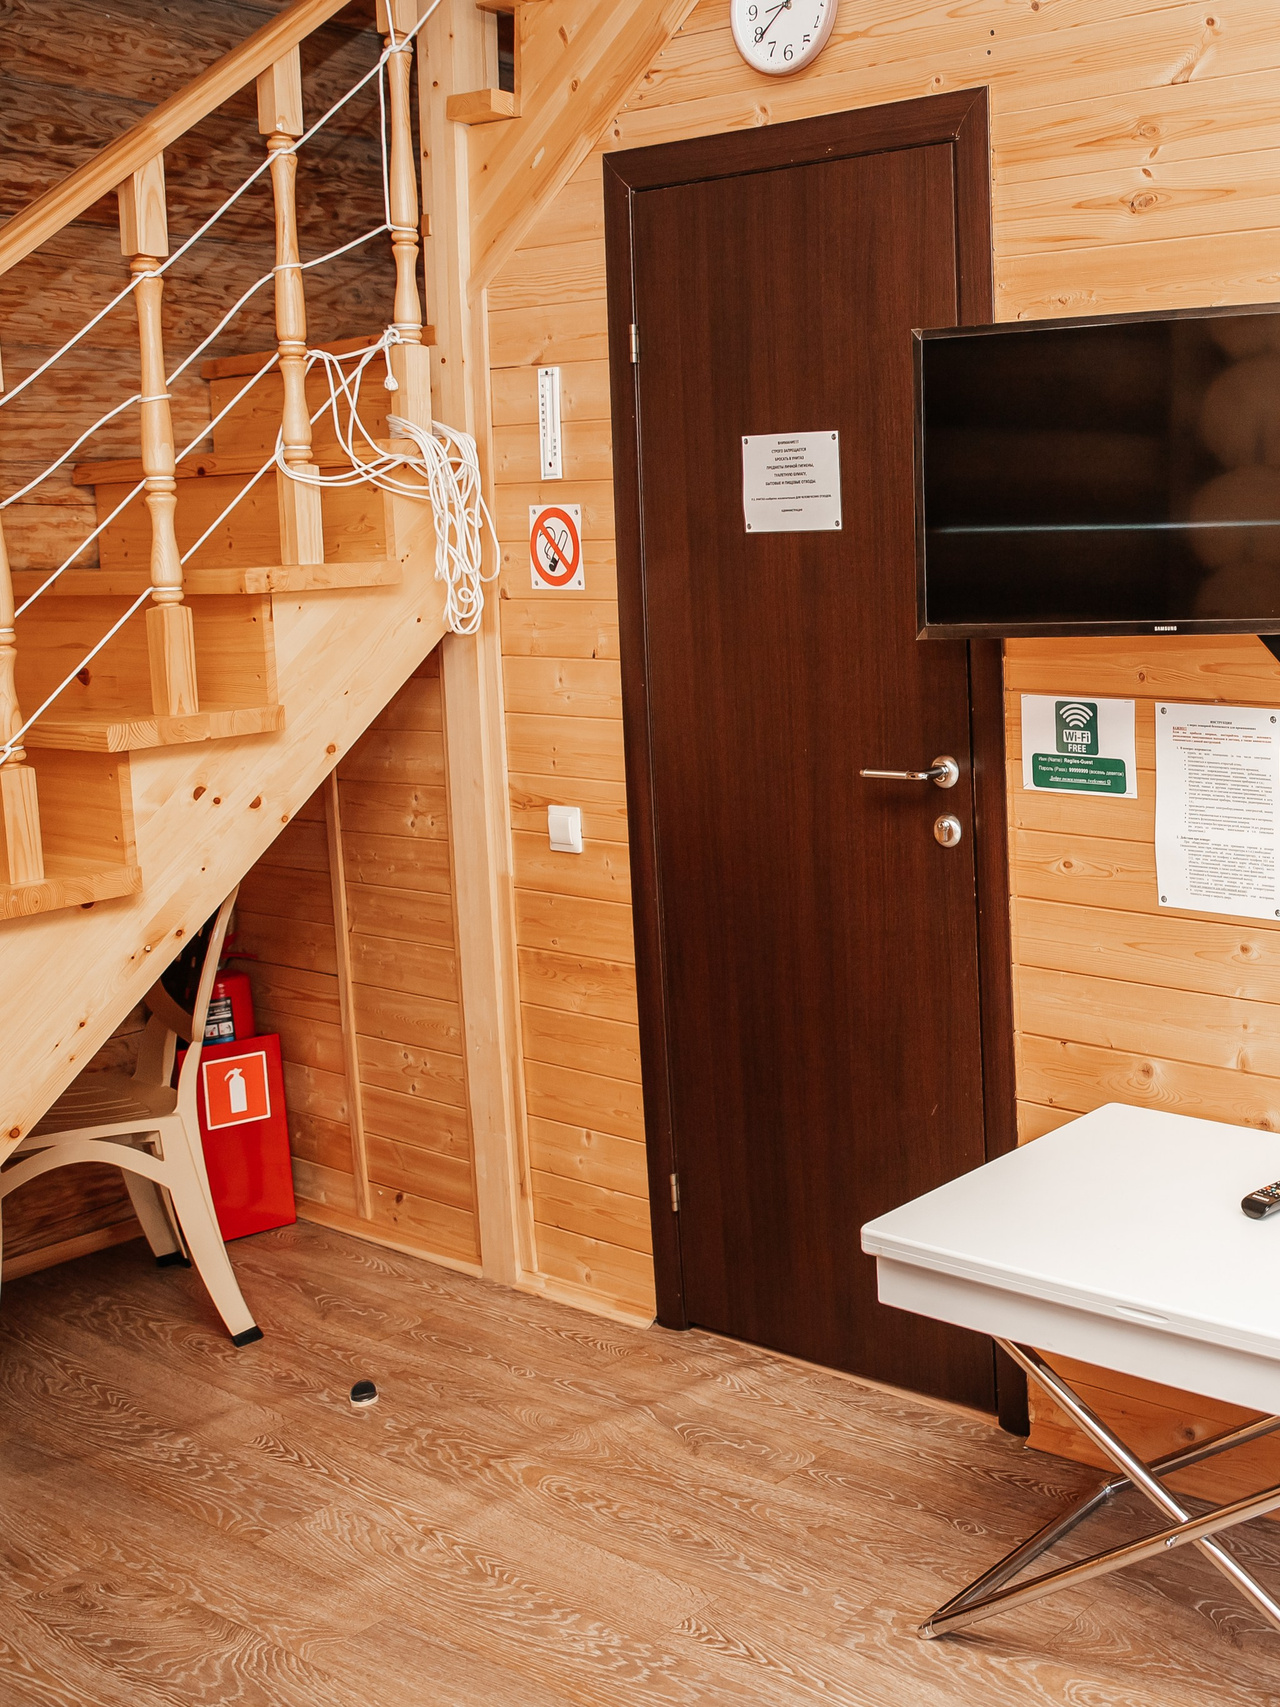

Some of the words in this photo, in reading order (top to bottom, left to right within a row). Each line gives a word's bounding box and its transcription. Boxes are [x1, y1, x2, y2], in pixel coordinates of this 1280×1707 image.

[748, 4, 758, 21] 9
[754, 26, 764, 43] 8
[768, 40, 777, 58] 7
[783, 44, 794, 61] 6
[1064, 731, 1090, 743] Wi-Fi
[1068, 743, 1087, 753] FREE
